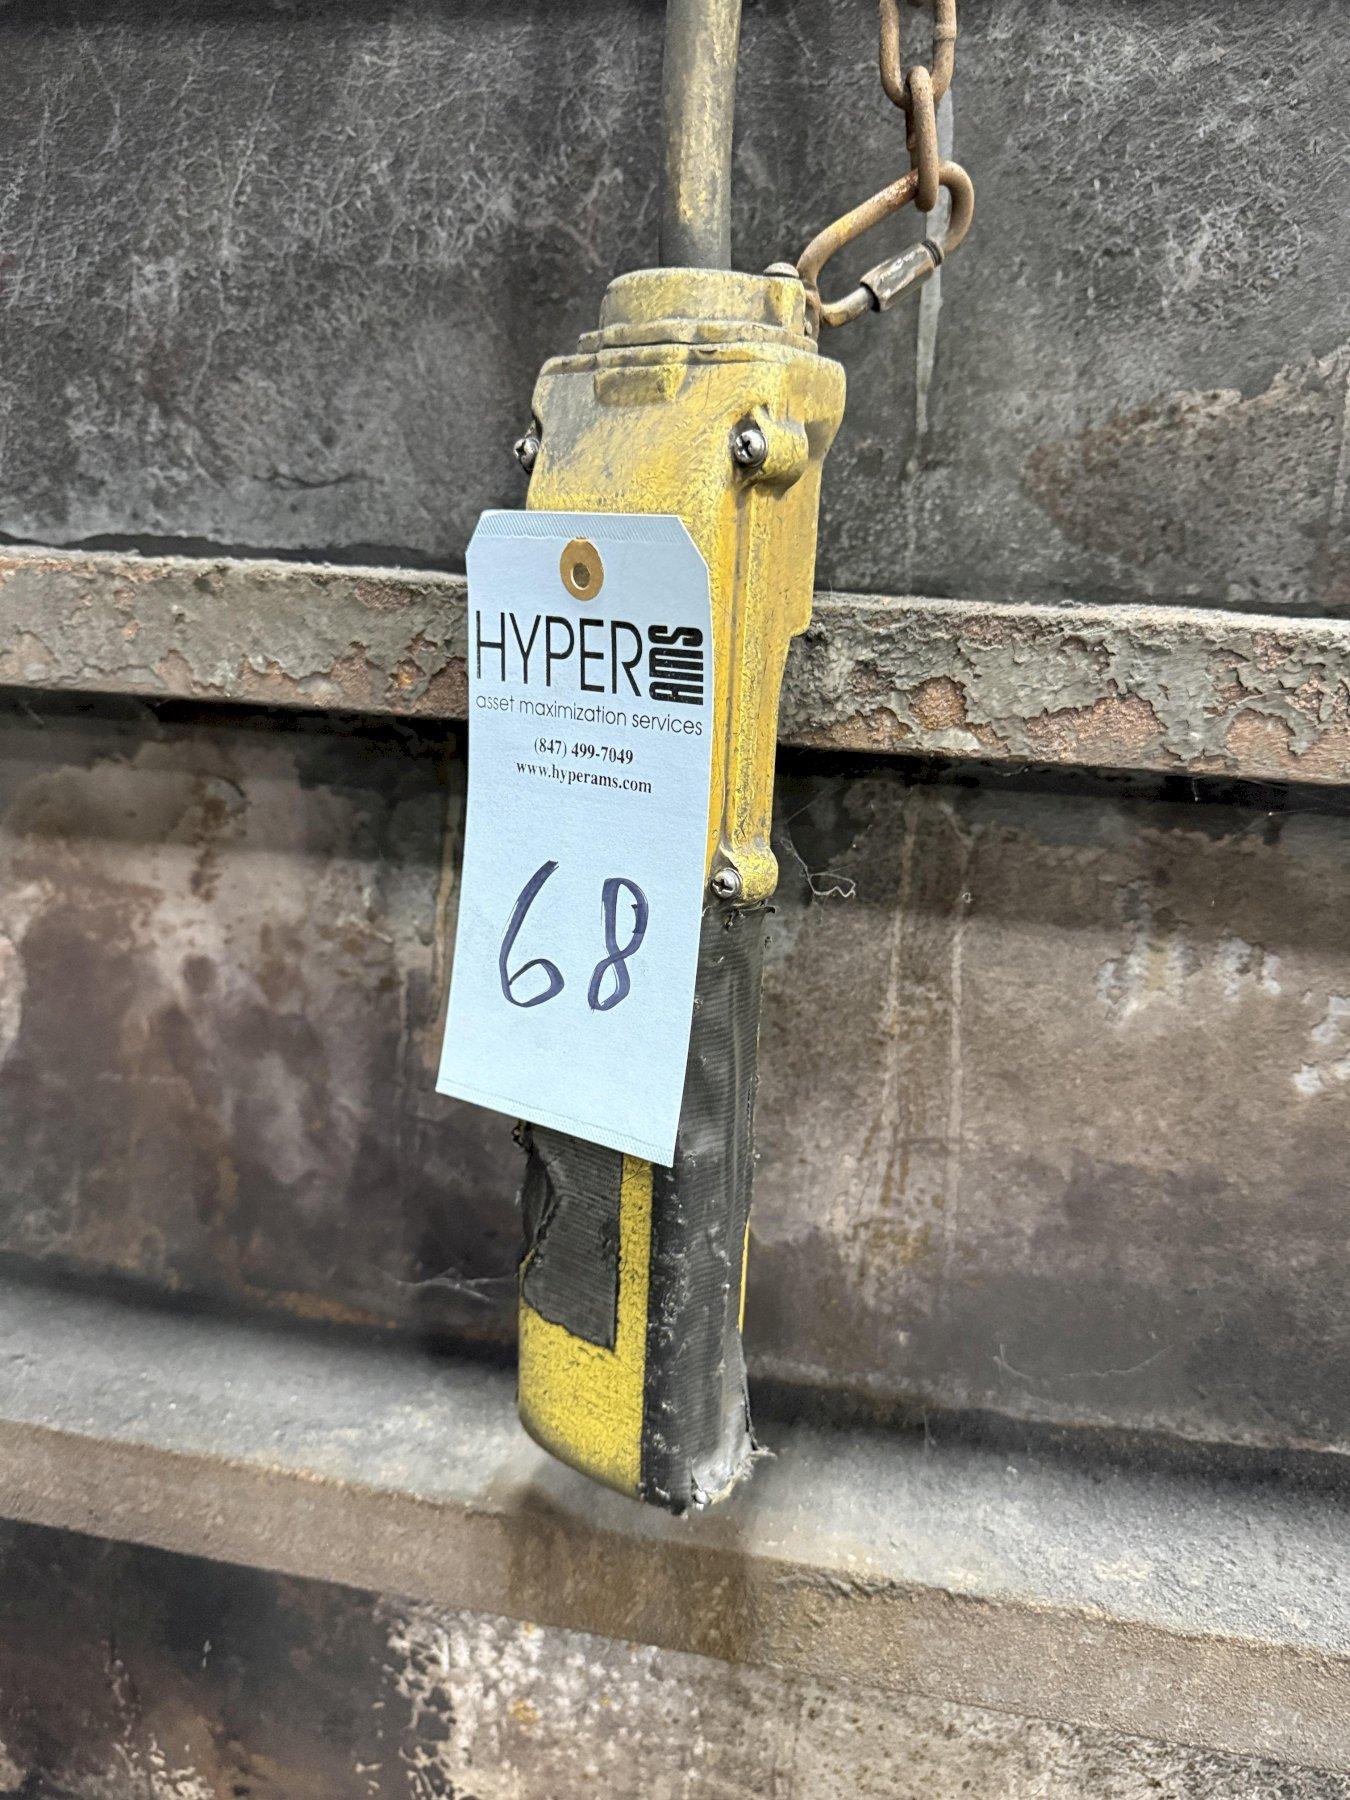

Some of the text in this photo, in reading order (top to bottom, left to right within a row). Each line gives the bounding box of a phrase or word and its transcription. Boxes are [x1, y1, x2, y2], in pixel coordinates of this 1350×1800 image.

[476, 610, 643, 697] HYPER
[475, 694, 703, 736] asset maximization services
[533, 737, 634, 765] (847) 499-7049
[516, 762, 652, 794] www.hyperams.com
[499, 860, 649, 1013] 68
